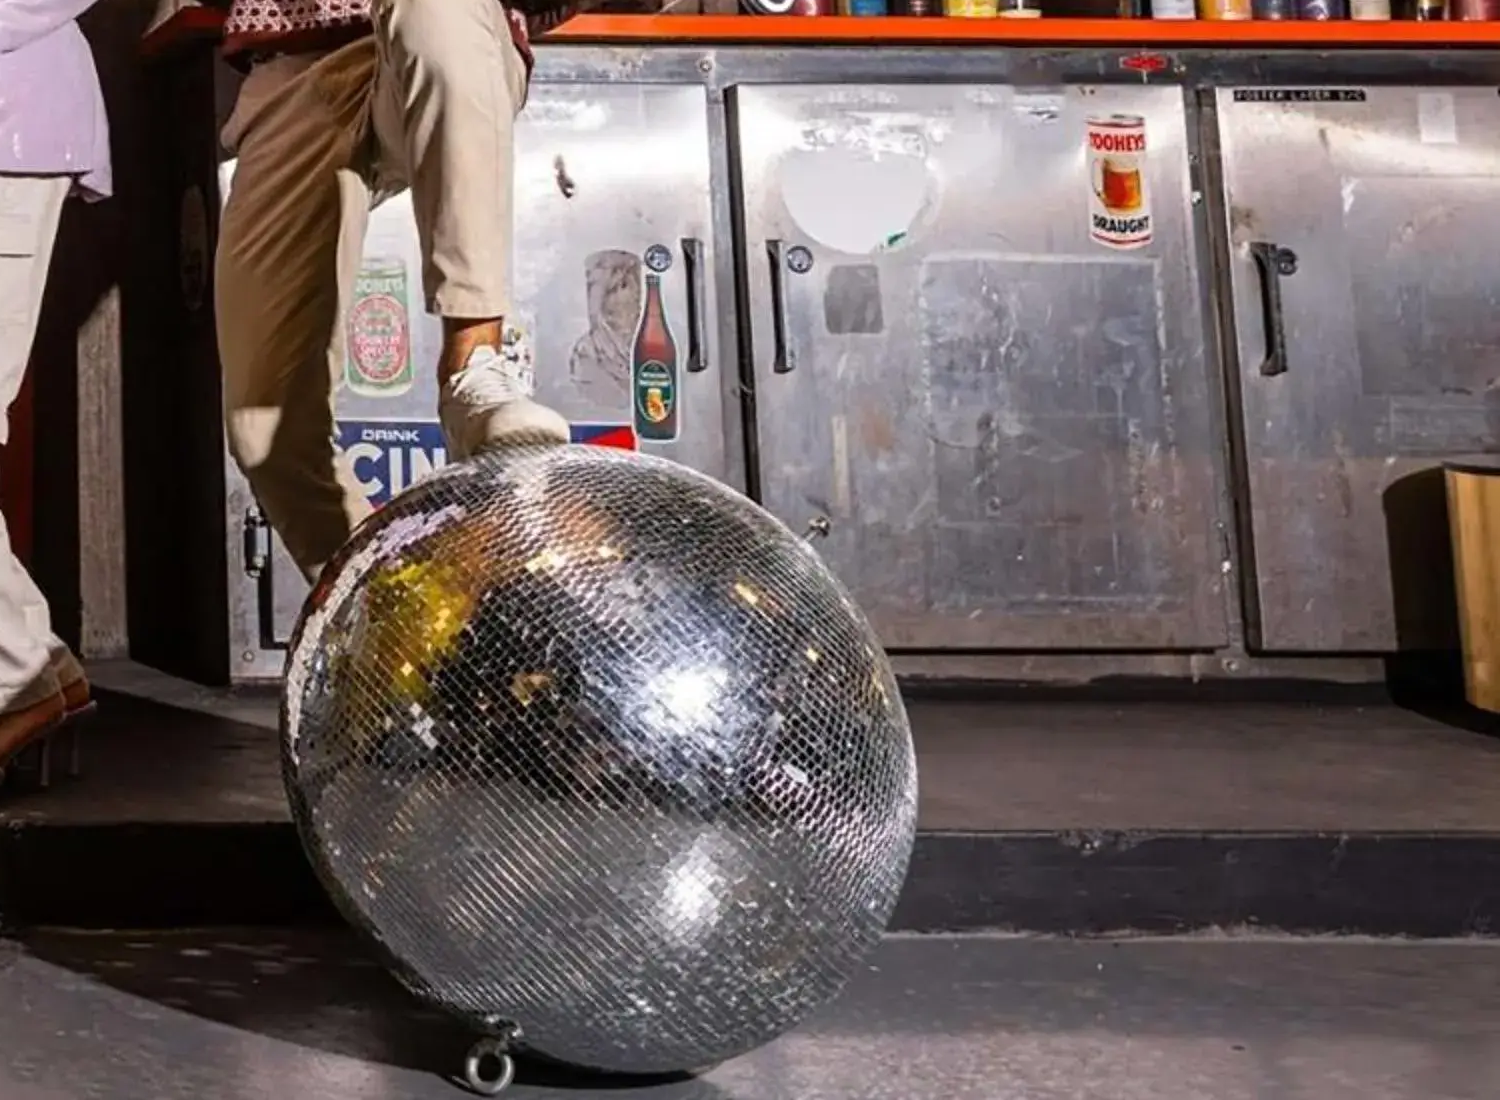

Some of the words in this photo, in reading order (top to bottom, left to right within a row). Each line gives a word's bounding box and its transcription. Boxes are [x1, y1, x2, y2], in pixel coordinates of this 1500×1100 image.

[1088, 132, 1146, 151] TOOHEYS
[1092, 213, 1150, 233] DRAUGHT
[361, 429, 421, 442] DRINK
[342, 442, 446, 500] CIN
